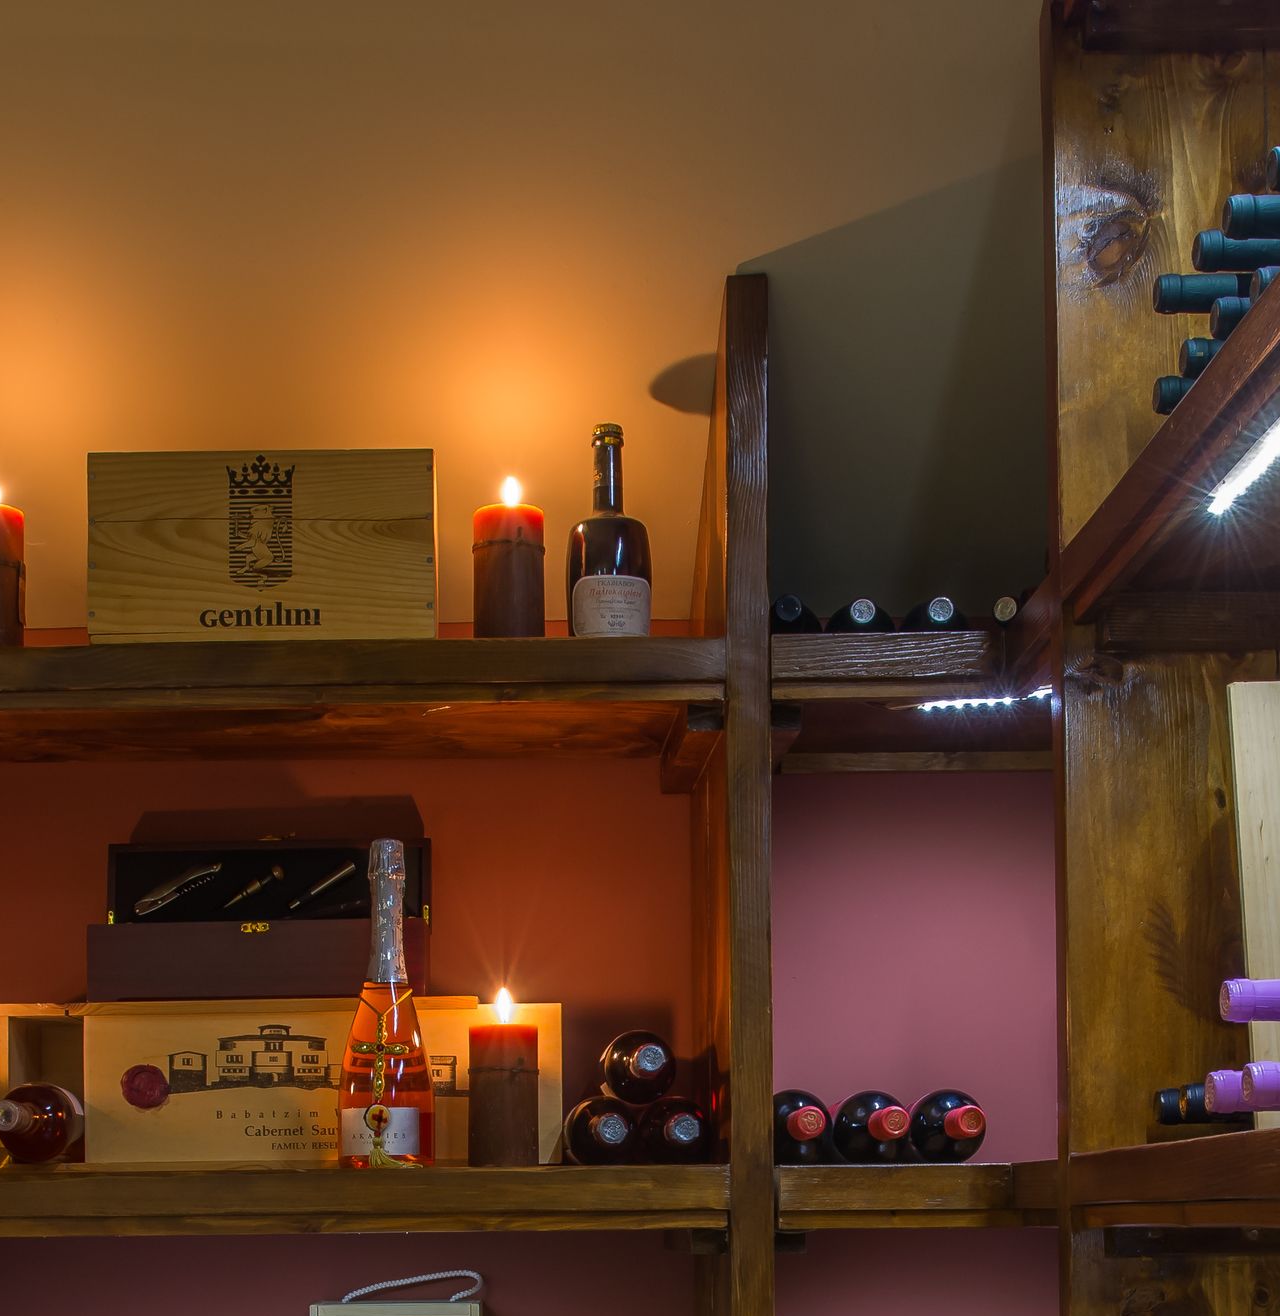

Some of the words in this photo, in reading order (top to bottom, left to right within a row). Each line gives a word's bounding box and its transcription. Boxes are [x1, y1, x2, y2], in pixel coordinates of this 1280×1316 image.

[216, 1109, 319, 1120] Babatzim
[244, 1125, 304, 1137] Cabernet
[271, 1142, 308, 1151] FAMILY
